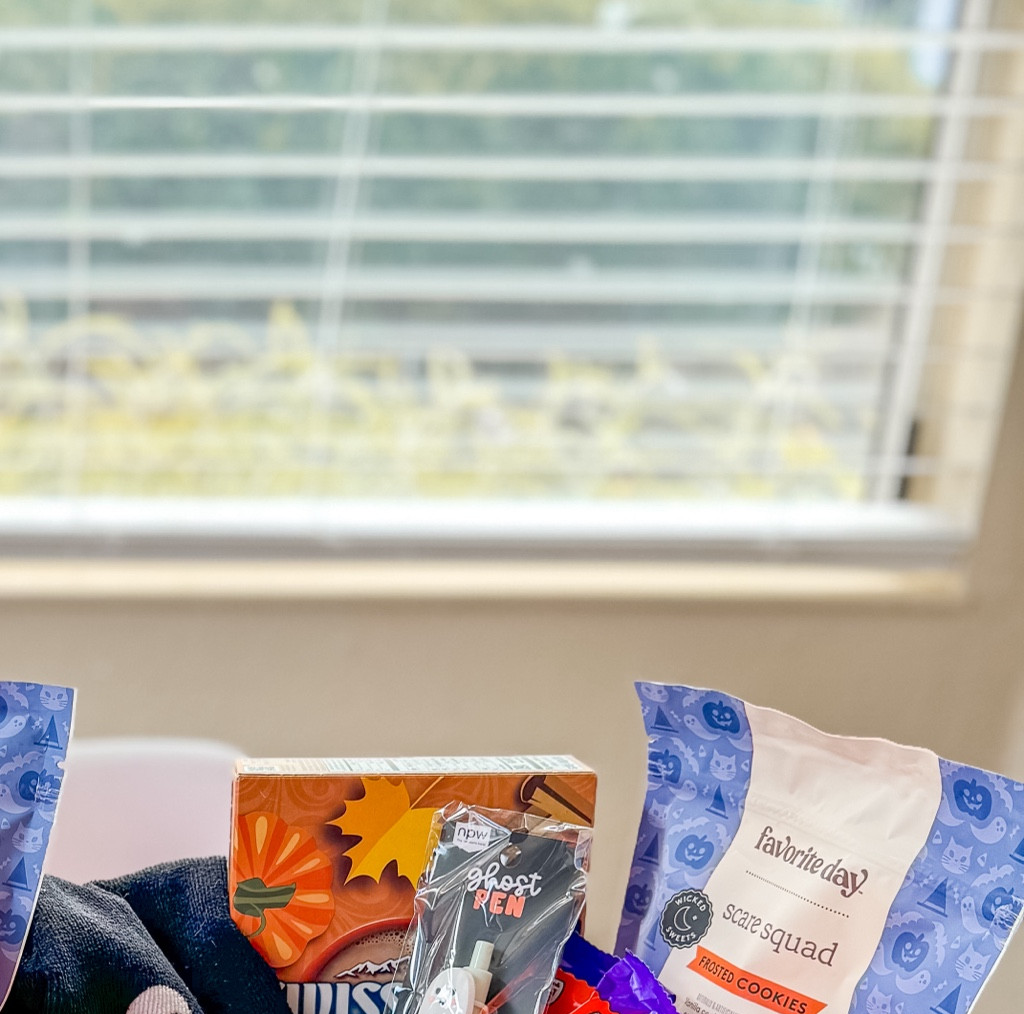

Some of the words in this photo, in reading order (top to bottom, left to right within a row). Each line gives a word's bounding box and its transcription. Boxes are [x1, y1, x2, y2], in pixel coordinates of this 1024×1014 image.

[457, 827, 488, 840] npw
[754, 826, 824, 874] favorite
[820, 859, 869, 898] day
[467, 862, 542, 896] ghost
[473, 889, 526, 918] PEN
[674, 894, 707, 912] WICKED
[665, 926, 697, 943] SWEETS
[722, 903, 762, 934] scare
[760, 918, 839, 967] squad
[699, 955, 735, 984] FROSTED
[736, 977, 808, 1014] COOKIES
